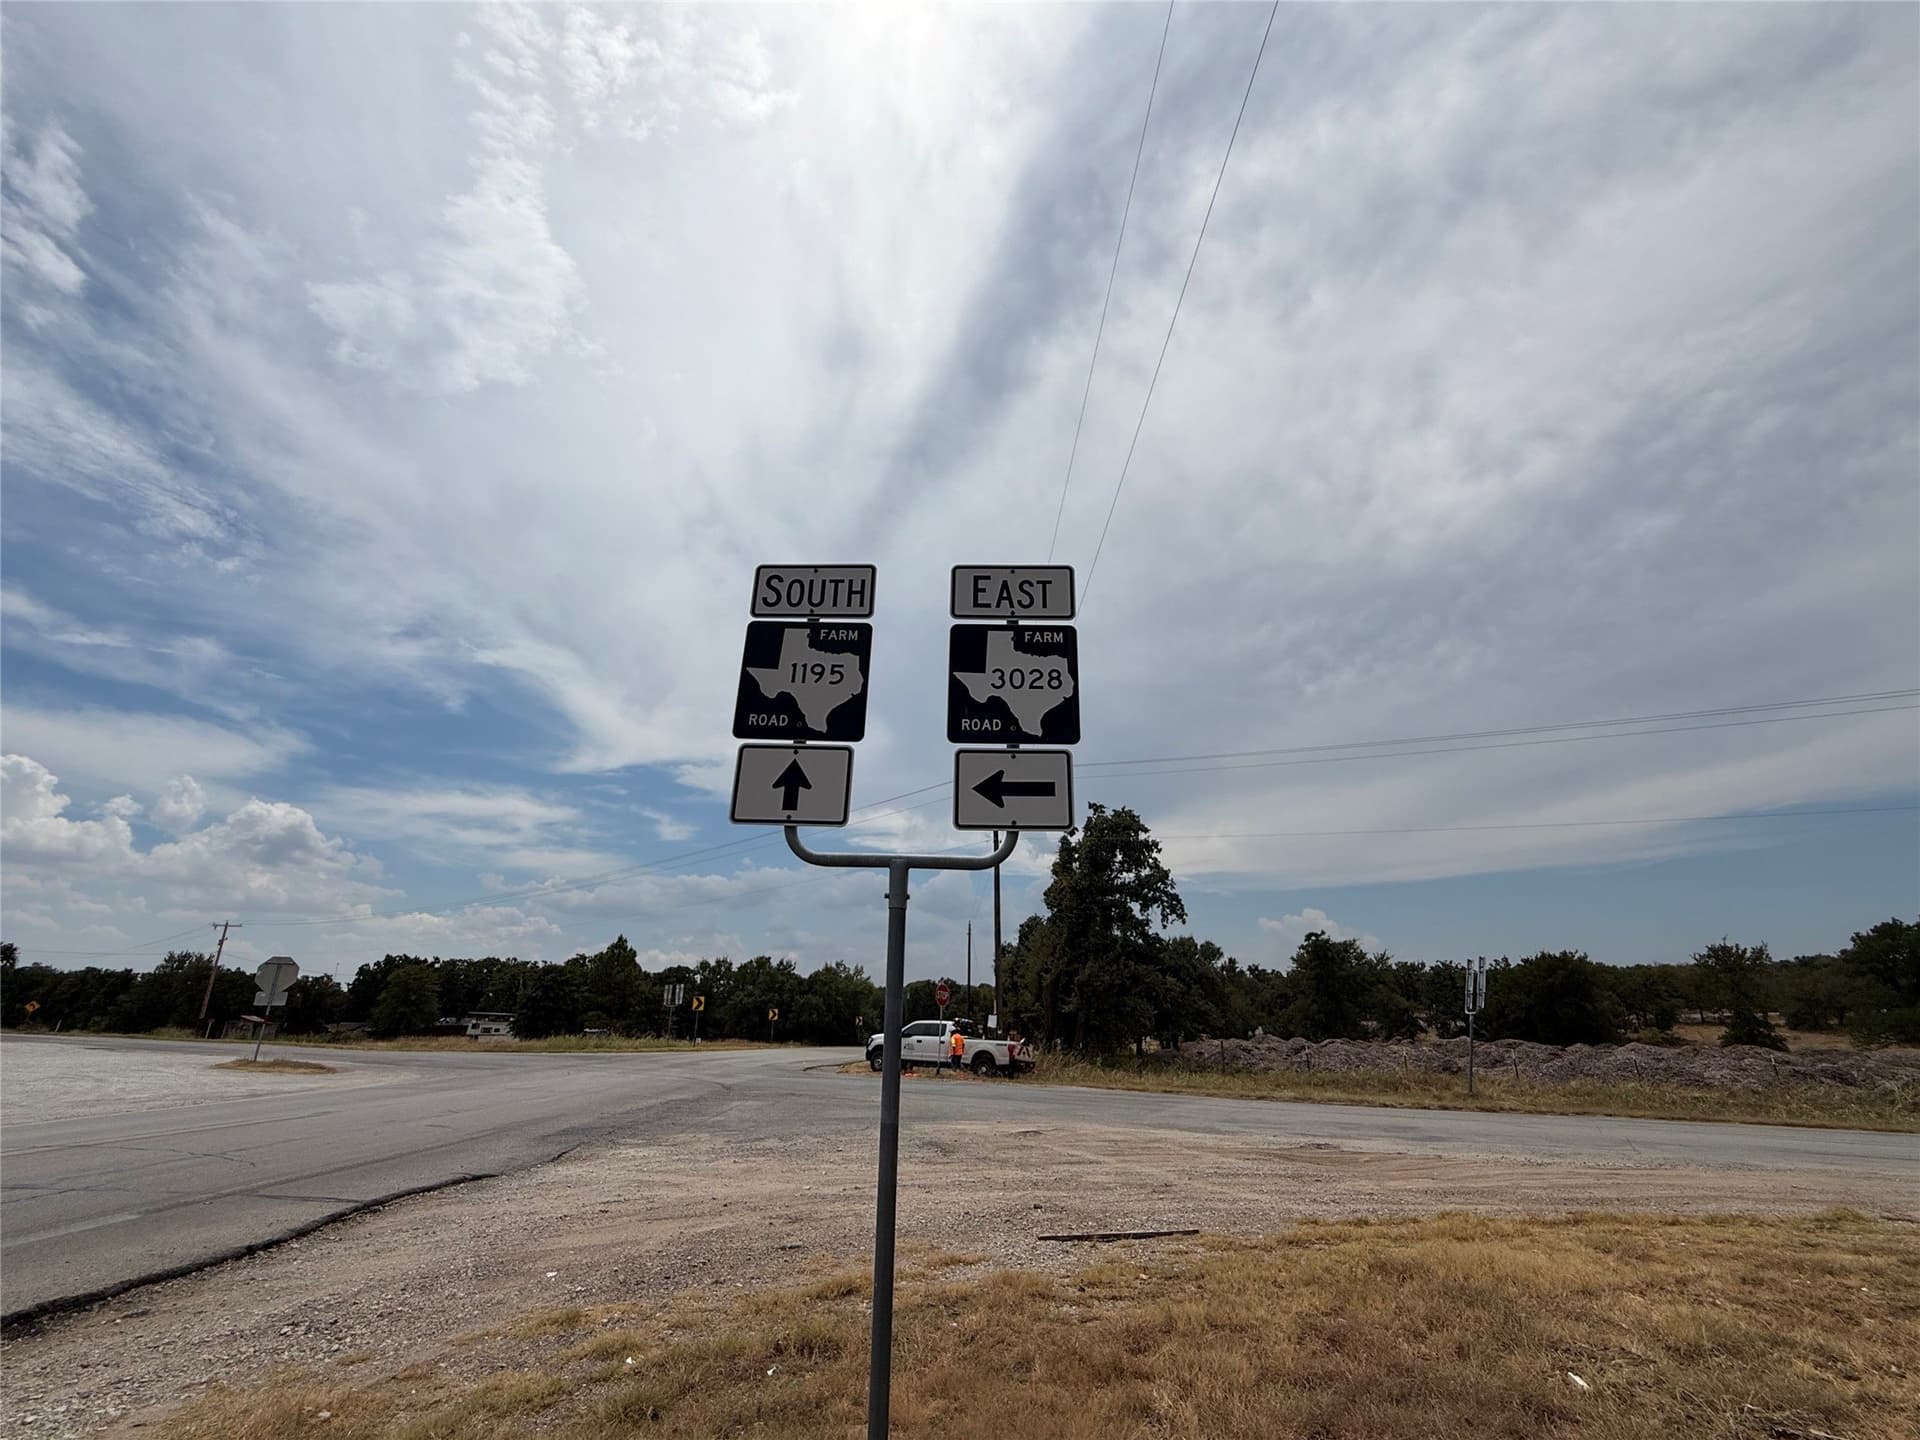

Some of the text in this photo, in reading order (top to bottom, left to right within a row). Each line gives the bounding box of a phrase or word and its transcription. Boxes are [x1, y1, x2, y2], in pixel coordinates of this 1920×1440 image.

[762, 574, 866, 608] SOUTH
[972, 575, 1053, 609] EAST
[820, 629, 859, 641] FARM
[1024, 631, 1064, 644] FARM
[790, 662, 845, 685] 1195
[990, 668, 1063, 690] 3028
[748, 713, 789, 726] ROAD
[961, 718, 1002, 731] ROAD
